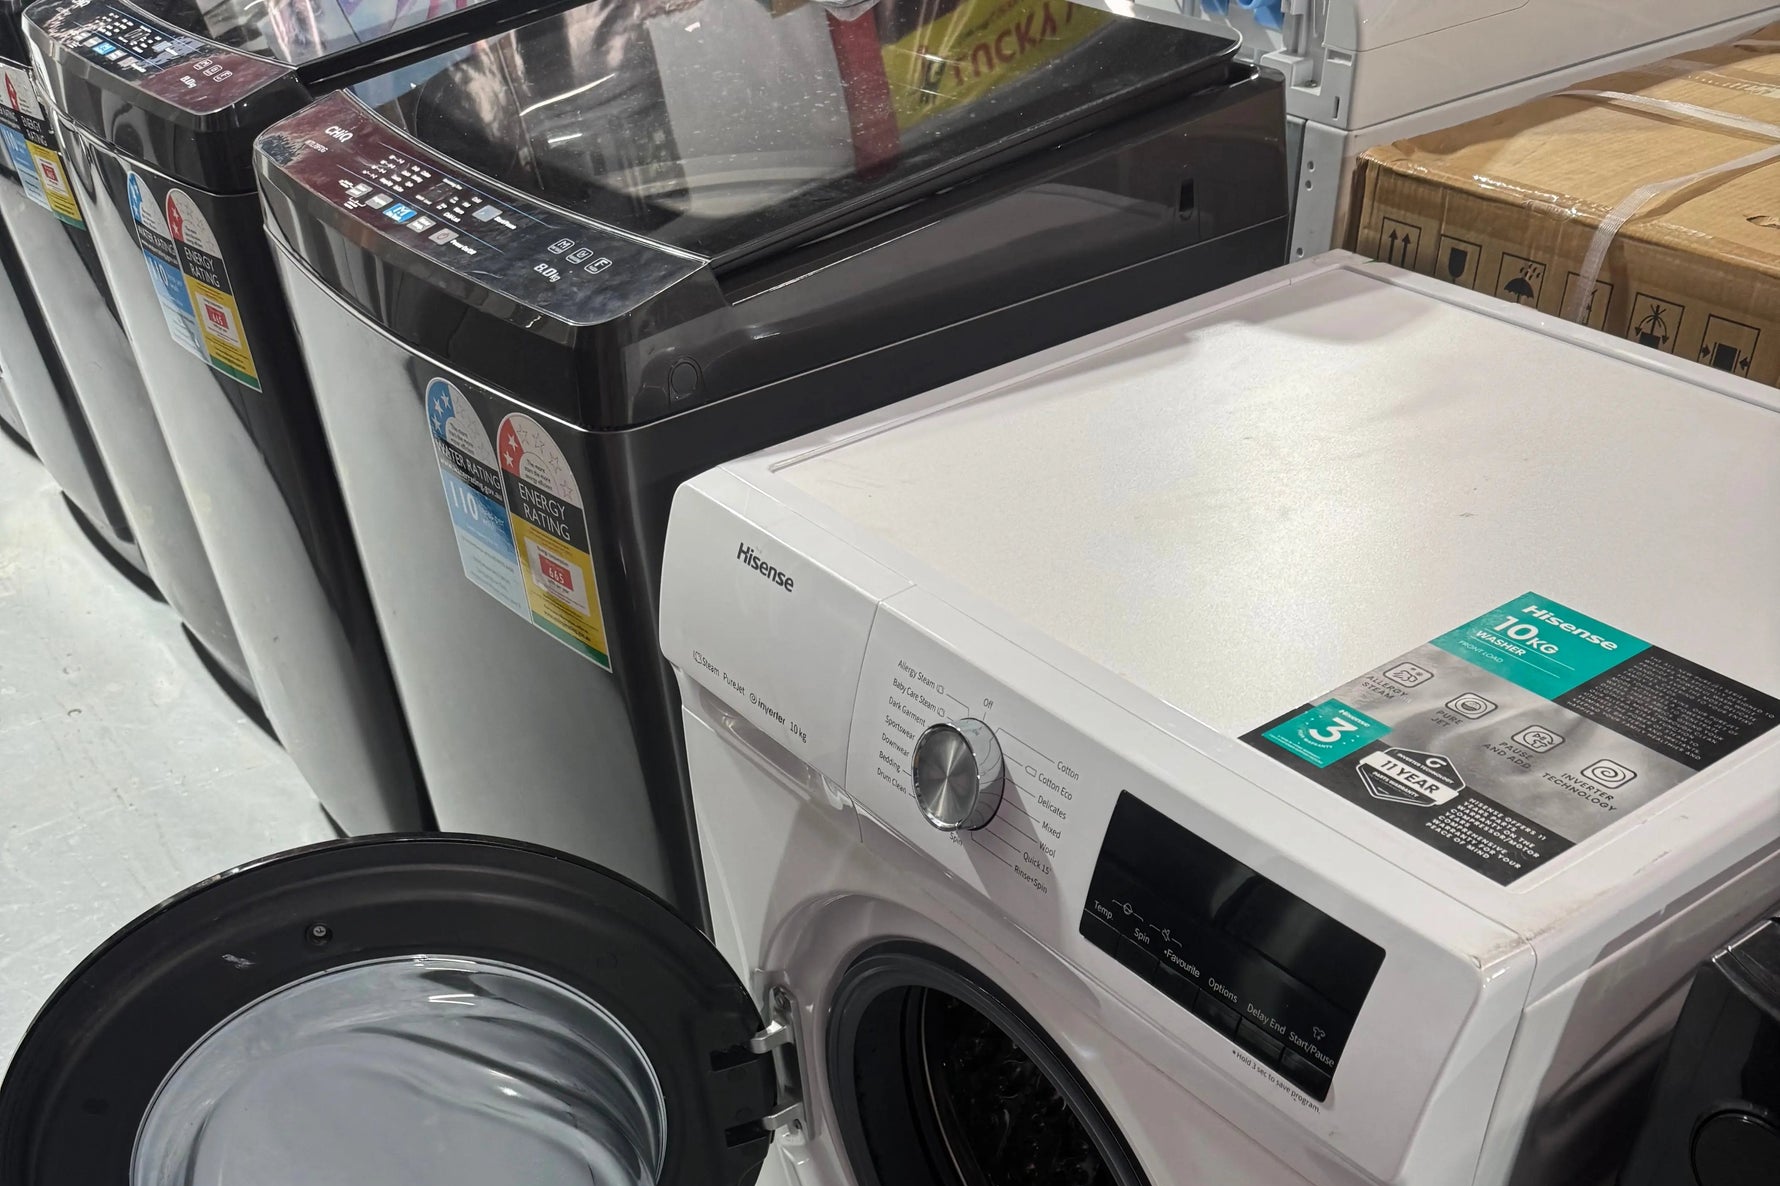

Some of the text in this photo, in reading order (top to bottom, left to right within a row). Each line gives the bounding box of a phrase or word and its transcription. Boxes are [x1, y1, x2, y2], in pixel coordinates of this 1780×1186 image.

[184, 247, 214, 272] ENERGY
[191, 263, 220, 288] RATING
[466, 459, 500, 490] RATING
[450, 480, 478, 521] 110
[518, 483, 565, 520] ENERGY
[524, 504, 570, 541] RATING
[737, 543, 794, 592] Hisense
[1494, 615, 1559, 655] 10KG
[1522, 605, 1618, 651] Hisense
[1476, 631, 1526, 656] WASHER
[898, 660, 935, 689] Allergy Steam
[1366, 674, 1410, 699] ALLERGY
[702, 657, 720, 677] Steam
[723, 673, 745, 696] PureJet
[758, 698, 785, 725] inverter
[893, 678, 937, 712] Baby Care Steam
[983, 698, 994, 710] Off
[1362, 681, 1398, 700] STEAM
[889, 696, 925, 727] Dark Garment
[1431, 717, 1451, 728] JET
[1436, 710, 1463, 726] PURE
[885, 715, 916, 741] Sportswear
[1309, 717, 1358, 743] 3
[882, 733, 910, 757] Downwear
[1482, 743, 1531, 770] AND ADD
[1499, 742, 1536, 760] PAUSE
[879, 751, 901, 773] Bedding
[1057, 761, 1079, 780] Cotton
[1418, 764, 1456, 784] TECHNOLOGY
[877, 768, 907, 794] Drum Clean
[1039, 773, 1072, 800] Cotton Eco
[1380, 760, 1393, 772] 11
[1398, 764, 1440, 795] YEAR
[1387, 779, 1420, 797] WARRANTY
[1561, 772, 1614, 801] INVERTER
[1542, 772, 1617, 812] TECHNOLOGY
[1038, 795, 1067, 820] Delicates
[1442, 811, 1471, 828] YEARS
[1461, 800, 1518, 832] YEARS PARTS
[1466, 797, 1505, 818] HISENSE
[1503, 816, 1538, 835] OFFERS
[950, 832, 963, 847] Spin
[1042, 821, 1061, 839] Mixed
[1436, 814, 1509, 855] COMPREHENSIVE
[1448, 807, 1541, 858] COMPRESSOR/MOTOR
[1455, 804, 1536, 848] WARRANTY ON THE
[1039, 841, 1056, 858] Wool
[1423, 821, 1491, 859] PEACE OF MIND
[1430, 818, 1523, 869] WARRANTY FOR YOUR
[1023, 852, 1040, 868] Quick
[1014, 865, 1048, 894] Rinse+Spin
[1094, 900, 1114, 921] Temp.
[1134, 928, 1150, 944] Spin
[1208, 977, 1238, 1003] Options
[1247, 1003, 1287, 1035] Delay End
[1289, 1031, 1335, 1067] Start/Pause
[1237, 1052, 1252, 1066] Hold
[1257, 1068, 1268, 1079] sec
[1268, 1073, 1275, 1083] to
[1275, 1079, 1291, 1094] save
[1291, 1088, 1321, 1114] program.
